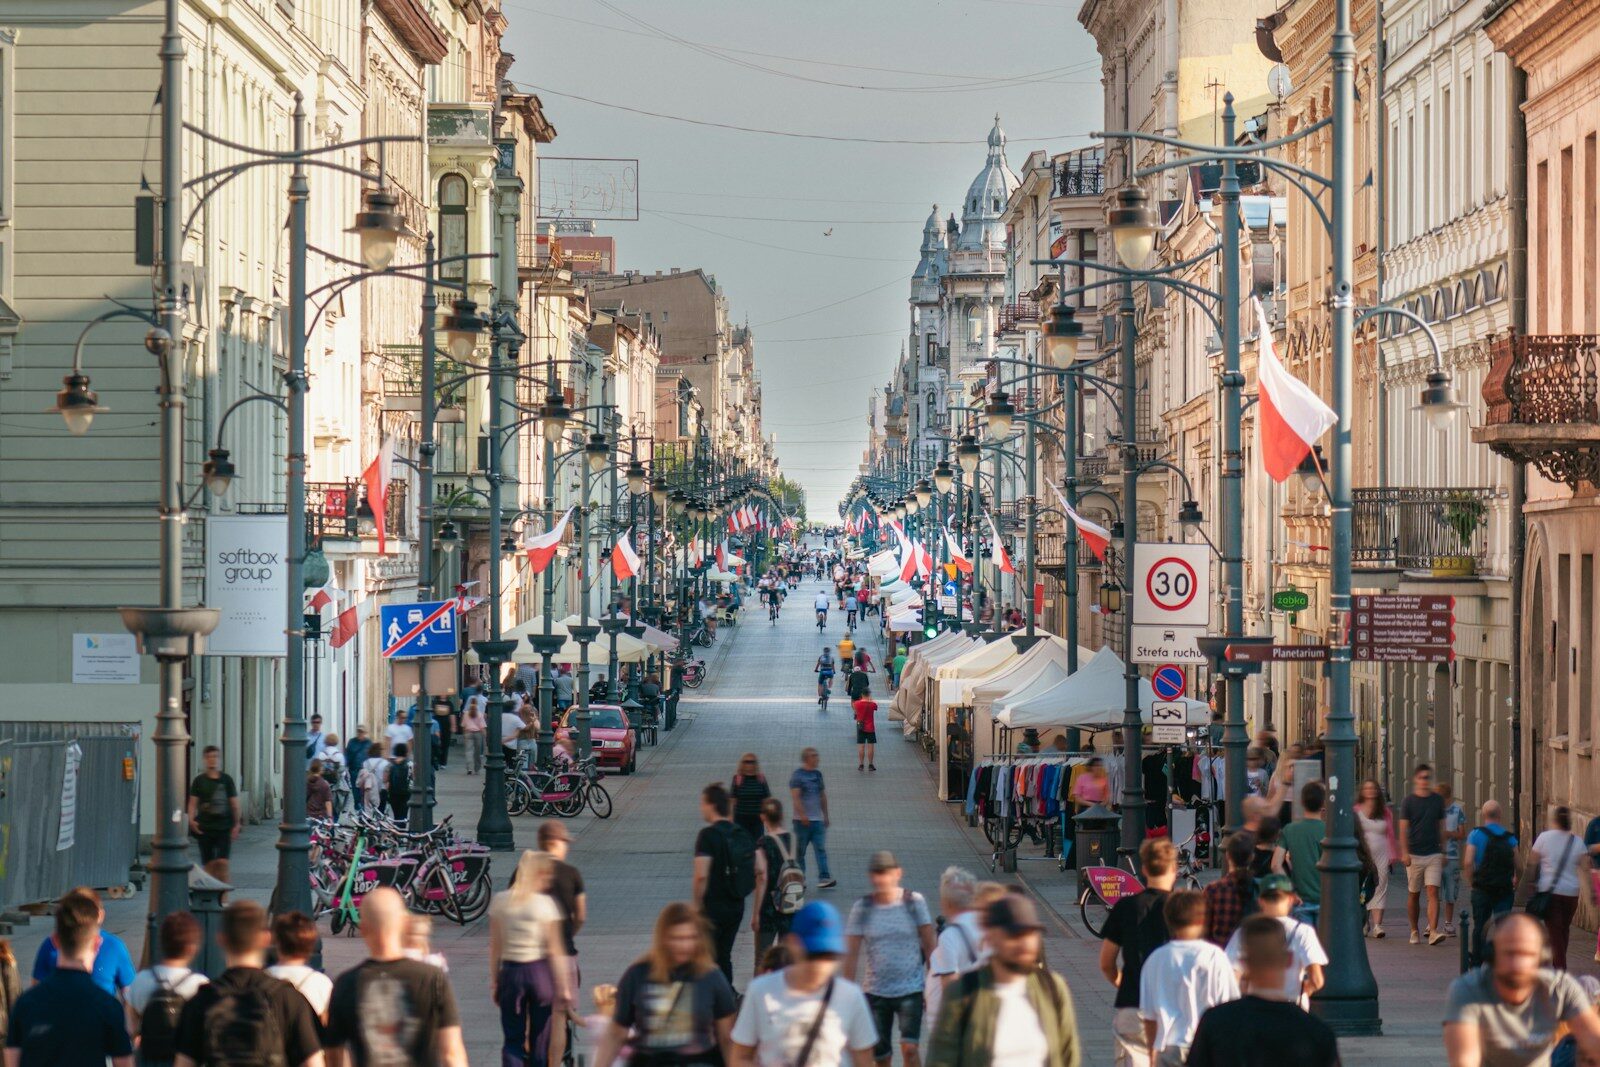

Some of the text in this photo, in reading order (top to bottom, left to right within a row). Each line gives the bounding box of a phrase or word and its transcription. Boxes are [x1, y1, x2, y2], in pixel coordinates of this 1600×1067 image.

[218, 548, 278, 565] softbox
[224, 567, 272, 584] group
[1155, 572, 1190, 596] 30
[1137, 646, 1168, 657] Strefa
[1272, 648, 1325, 658] Planetarium
